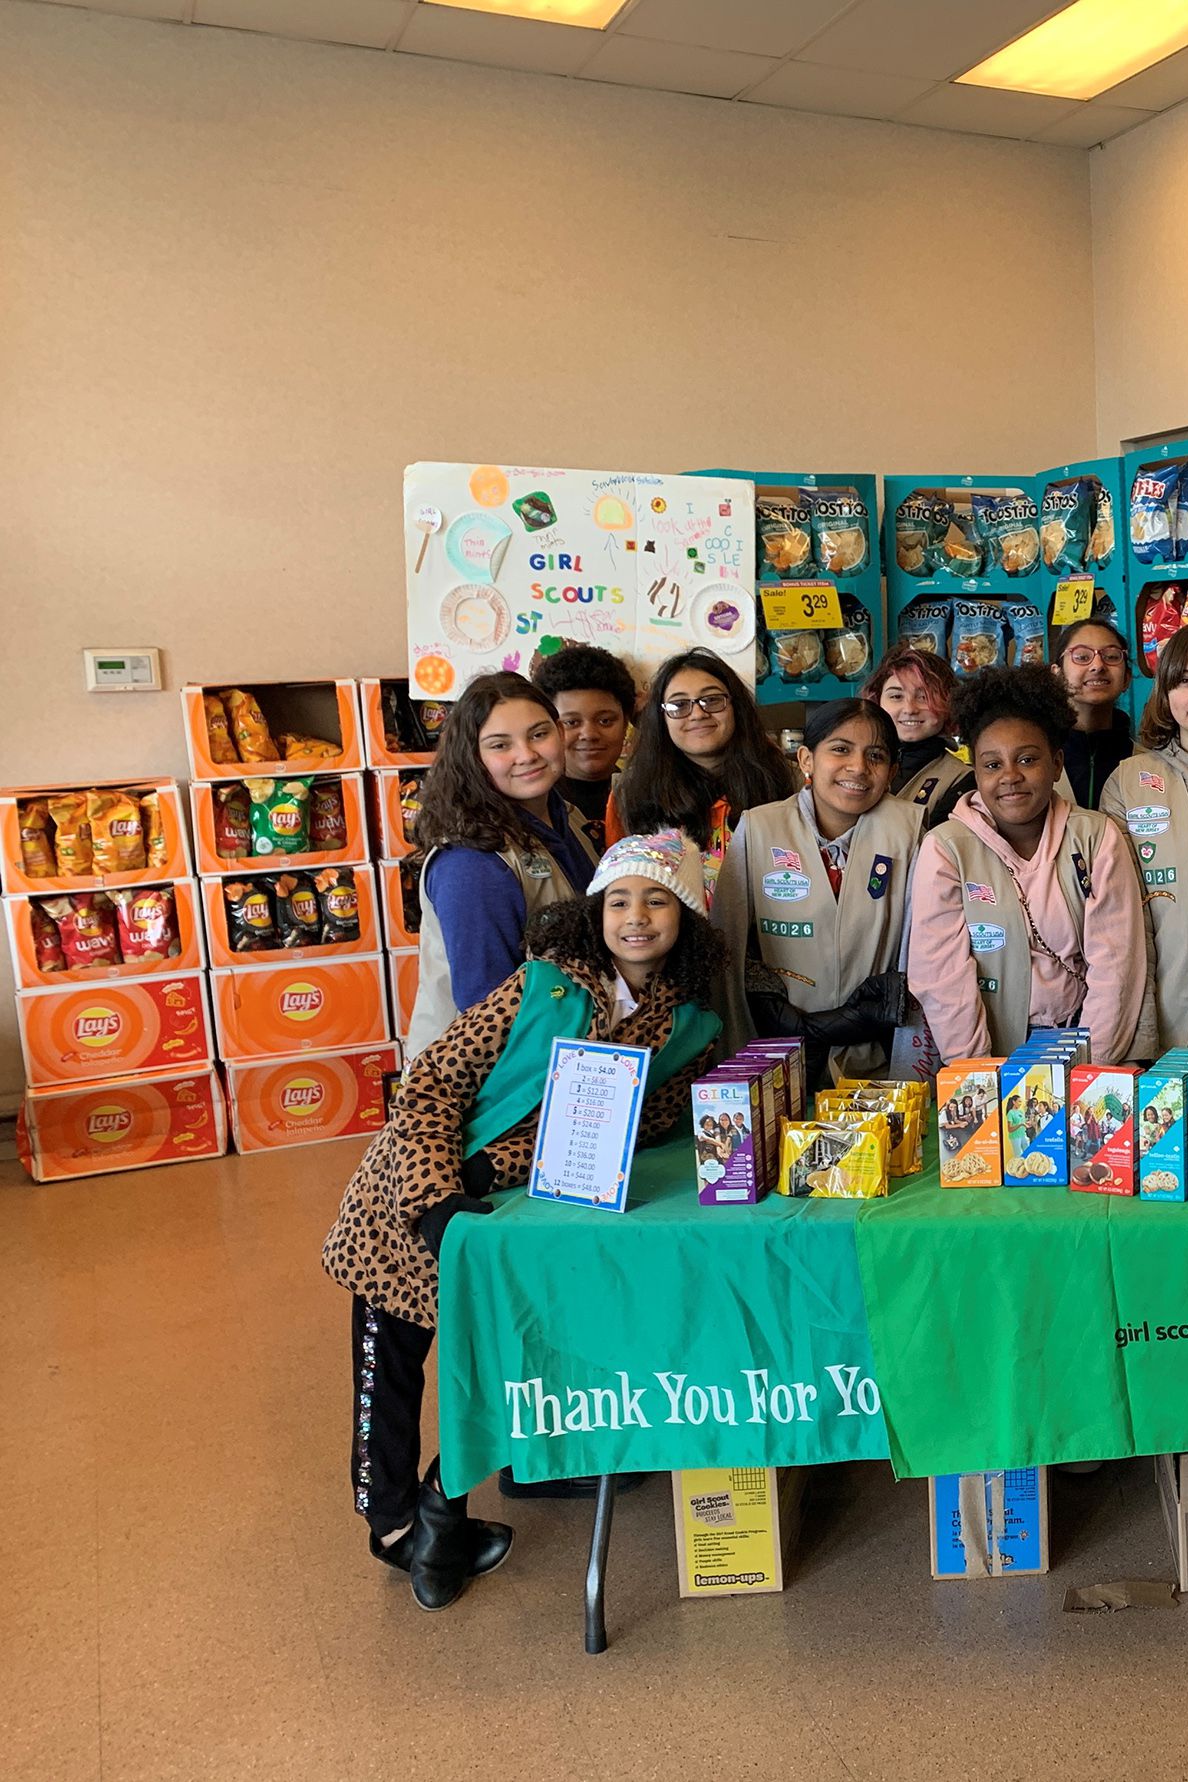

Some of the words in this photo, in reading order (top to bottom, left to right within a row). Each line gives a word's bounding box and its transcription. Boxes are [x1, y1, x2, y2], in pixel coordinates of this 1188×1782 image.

[529, 553, 583, 572] GIRL
[531, 582, 624, 604] SCOUTS
[763, 589, 786, 597] Sale!
[762, 919, 812, 936] 12026
[581, 1064, 592, 1073] box
[598, 1065, 616, 1075] $4.00
[587, 1086, 609, 1097] $12.00
[582, 1108, 605, 1119] $20.00
[581, 1120, 600, 1129] $24.00
[577, 1161, 595, 1171] $40.00
[575, 1172, 594, 1181] $44.00
[561, 1180, 577, 1189] boxes
[581, 1183, 600, 1192] $48.00
[1114, 1319, 1150, 1348] girl
[504, 1370, 653, 1439] Thank
[652, 1371, 740, 1426] You
[740, 1368, 818, 1425] For
[824, 1364, 880, 1417] Yo
[690, 1498, 706, 1506] Girl
[706, 1494, 729, 1503] Scout
[694, 1572, 764, 1587] lemon-ups
